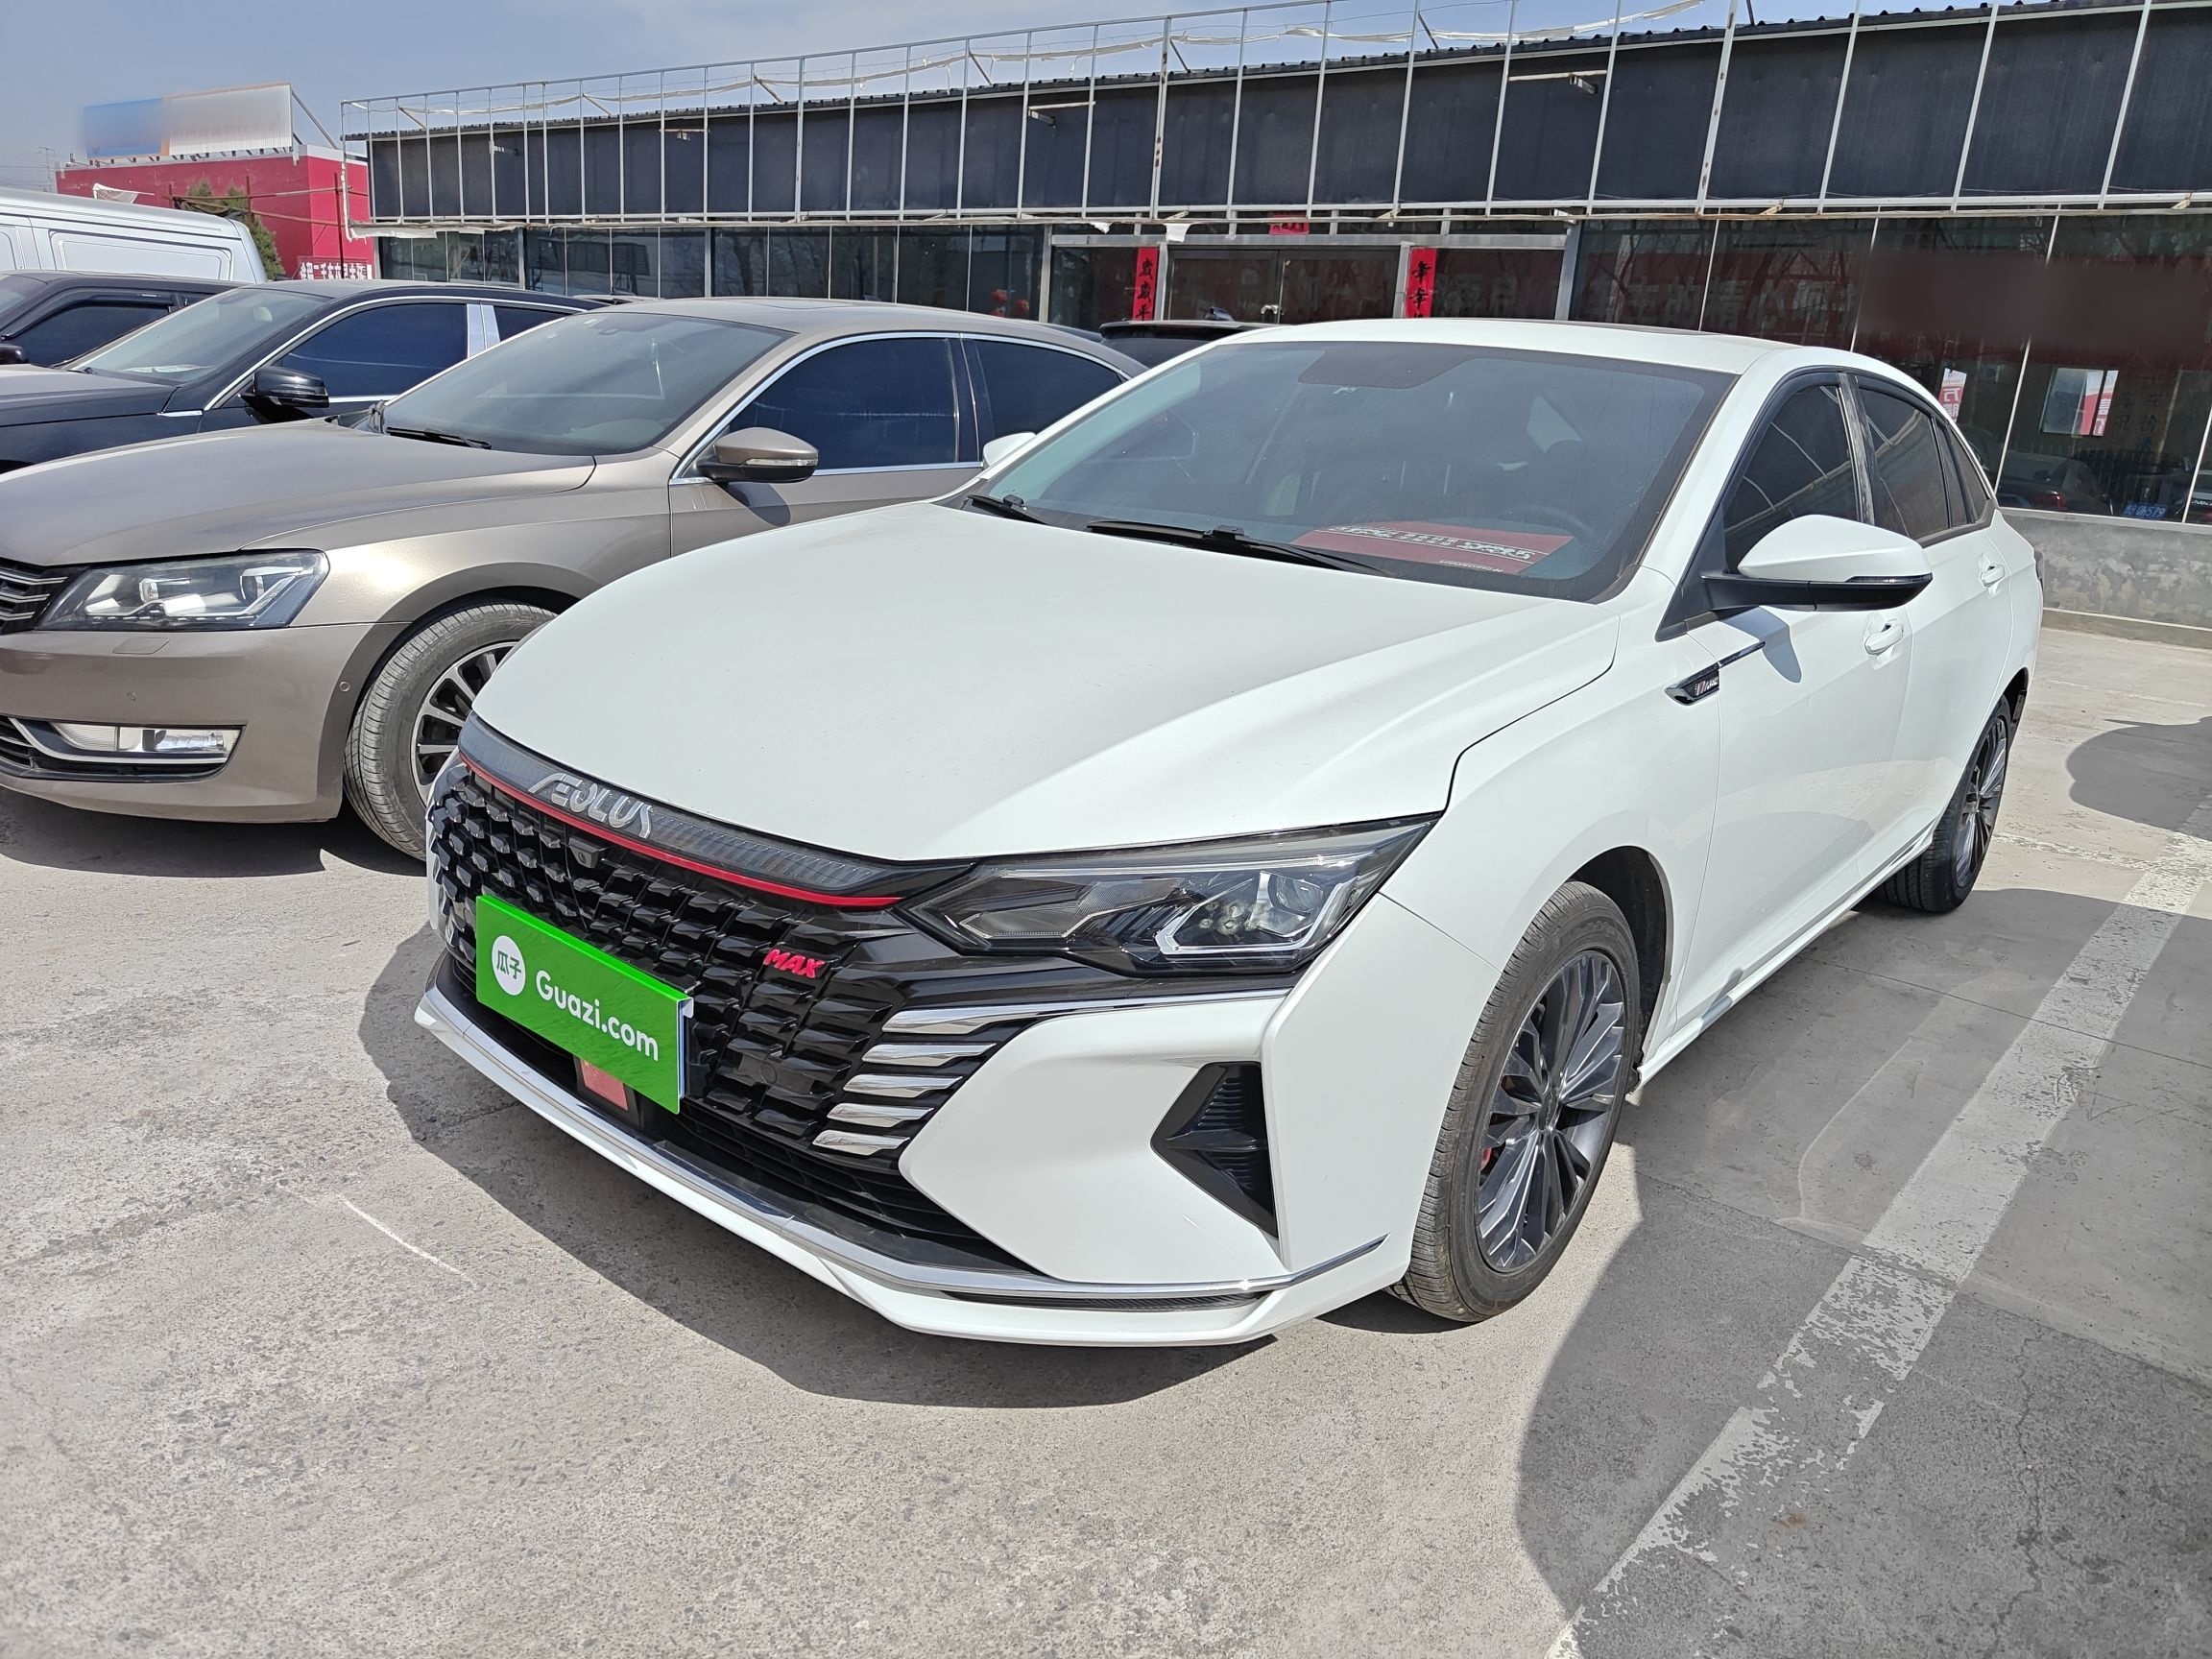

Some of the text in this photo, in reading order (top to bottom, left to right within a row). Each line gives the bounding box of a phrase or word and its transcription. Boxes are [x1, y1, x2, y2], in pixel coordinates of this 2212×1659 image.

[495, 949, 522, 980] 瓜子
[765, 949, 824, 978] MAX
[536, 969, 660, 1062] Guazi.com
